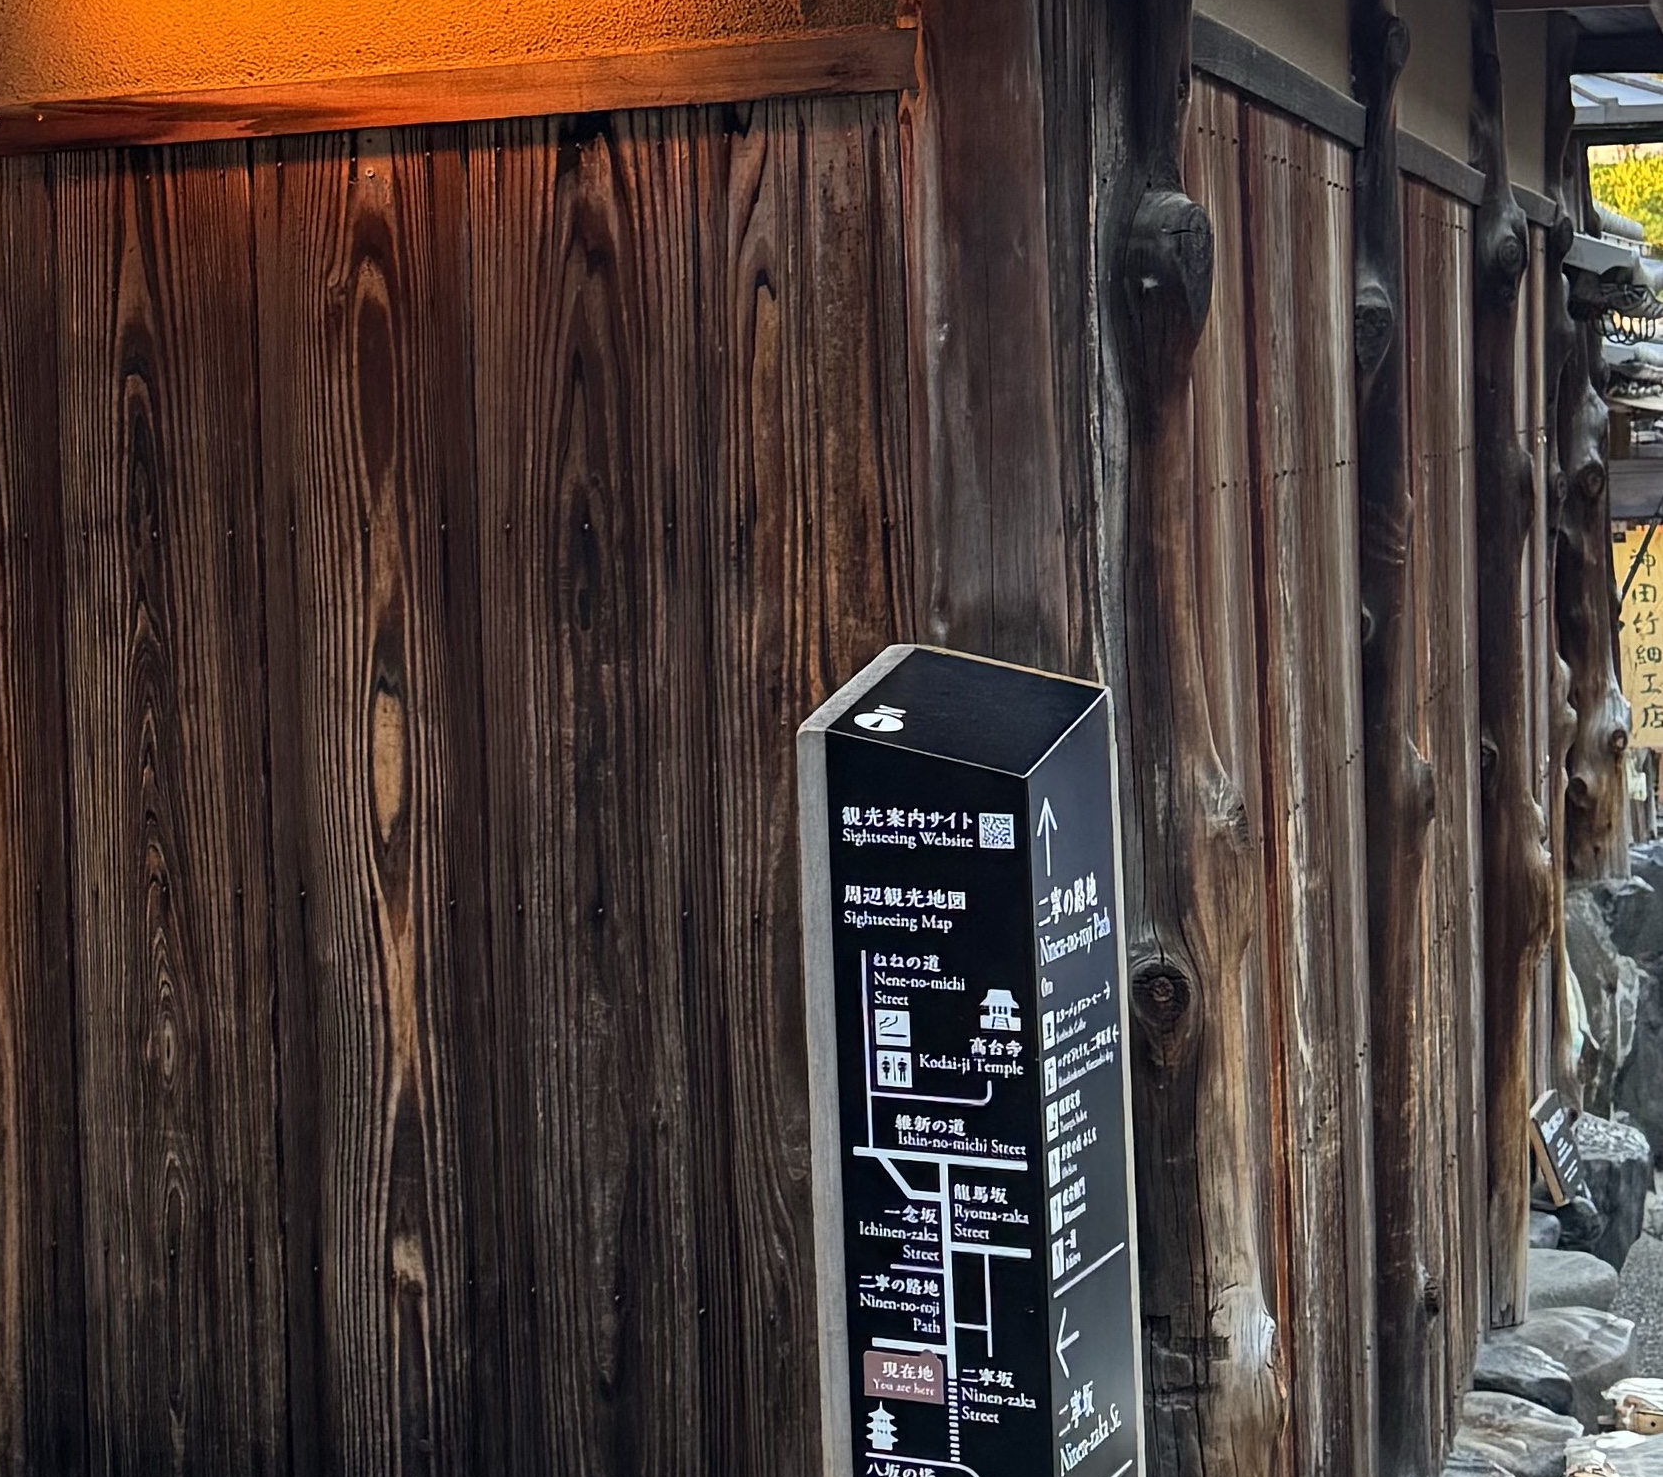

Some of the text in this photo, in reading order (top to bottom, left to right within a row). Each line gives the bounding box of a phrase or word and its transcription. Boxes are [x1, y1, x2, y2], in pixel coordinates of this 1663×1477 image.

[842, 806, 973, 830] 観光案内サイト
[842, 828, 974, 849] Sightseeing Website
[843, 884, 966, 910] 周辺観光地図
[843, 910, 953, 934] Sightseeing Map
[873, 953, 942, 972] ねねの道
[873, 971, 966, 991] Nene-no-michi
[874, 990, 909, 1006] Street
[969, 1037, 1023, 1057] 高台寺
[919, 1053, 1024, 1078] Kodai-ji Temple
[895, 1114, 966, 1136] 維新の道
[897, 1131, 1027, 1156] Ishin-no-michi Street
[884, 1205, 938, 1224] 一念坂
[954, 1203, 1029, 1225] Ryoma-zaka
[859, 1221, 939, 1242] Ichinen-zaka
[954, 1223, 990, 1240] Street
[903, 1244, 939, 1261] Street
[859, 1292, 940, 1317] Ninen-no-roji
[913, 1317, 941, 1334] Path
[882, 1361, 934, 1382] 現在地
[873, 1378, 935, 1396] You are here
[961, 1387, 1036, 1409] Ninen-zaka
[961, 1406, 1000, 1423] Street
